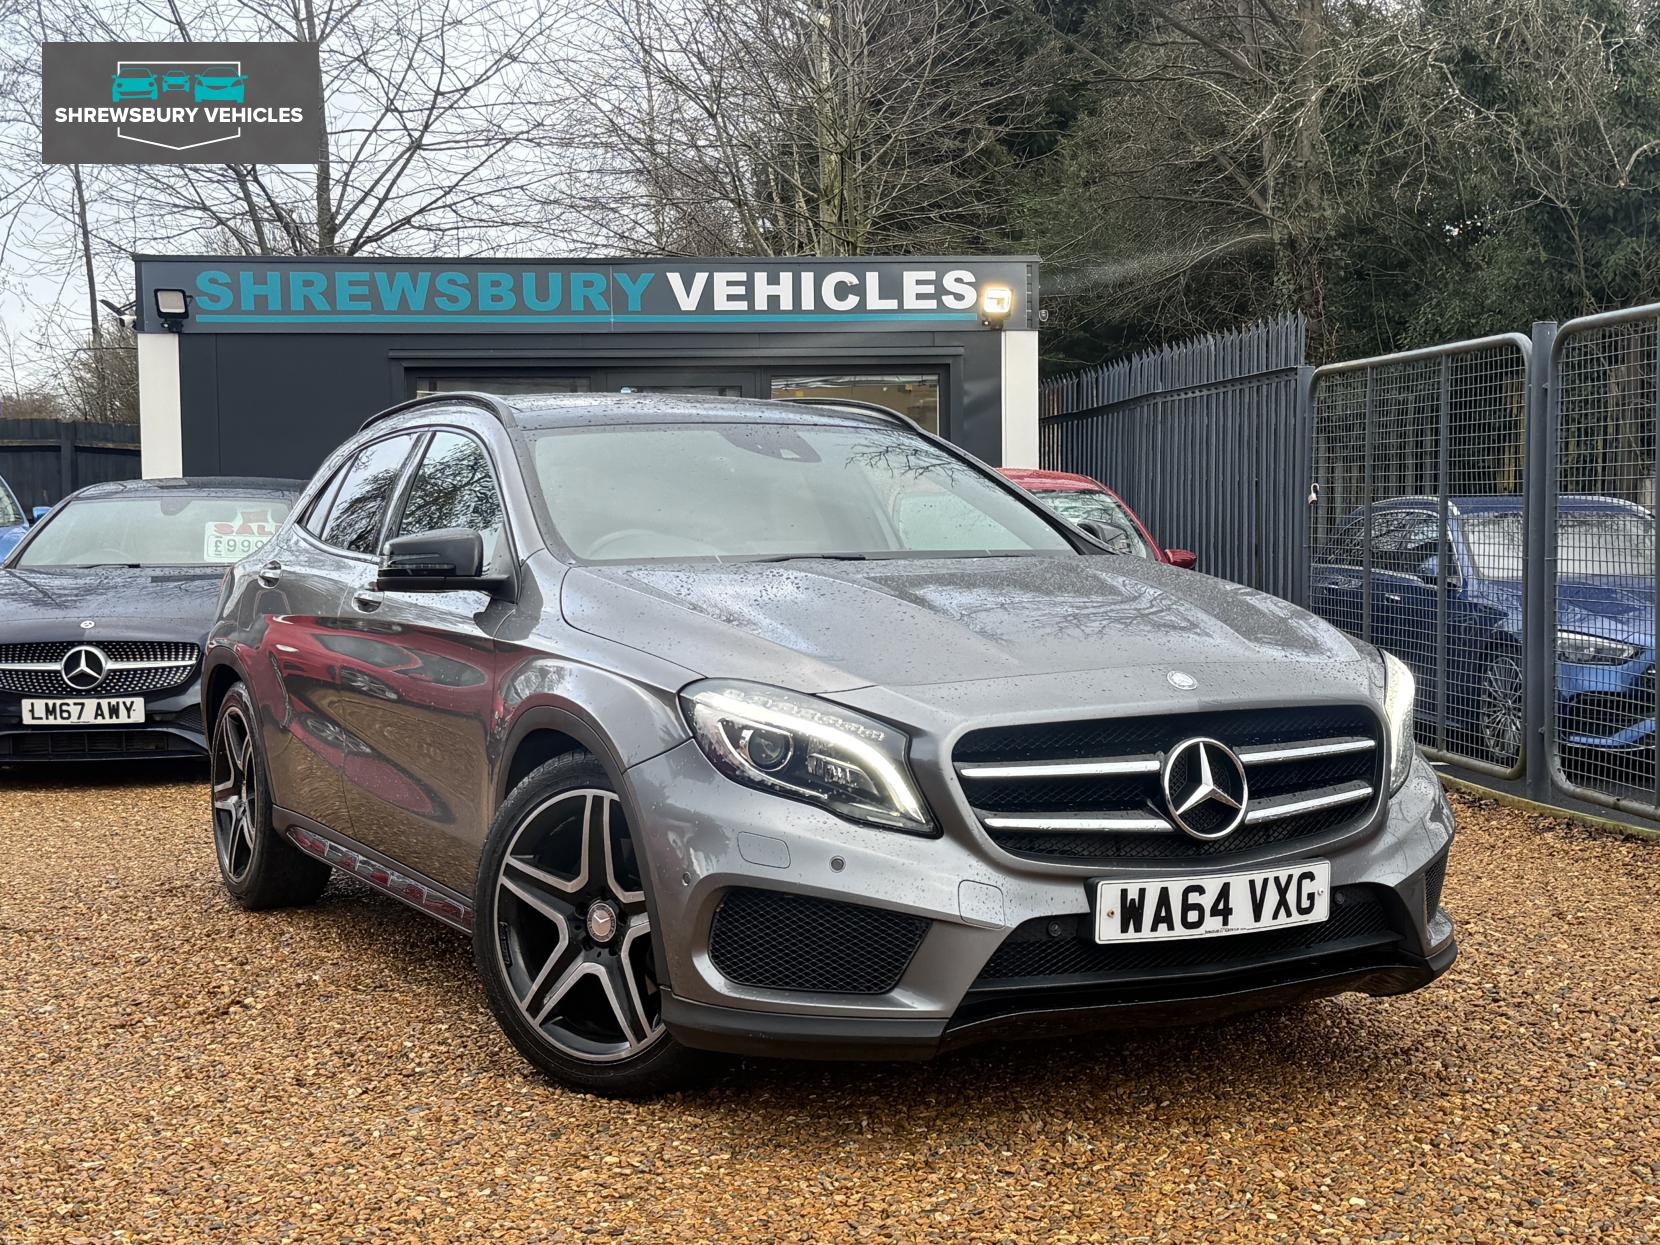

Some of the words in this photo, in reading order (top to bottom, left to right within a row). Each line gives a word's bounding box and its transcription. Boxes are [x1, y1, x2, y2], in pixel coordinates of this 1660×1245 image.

[195, 271, 656, 312] SHREWSBURY
[665, 269, 978, 312] VEHICLES
[30, 701, 86, 721] LM67
[94, 700, 135, 720] AWY
[1119, 881, 1234, 934] WA64
[1248, 870, 1317, 923] VXG
